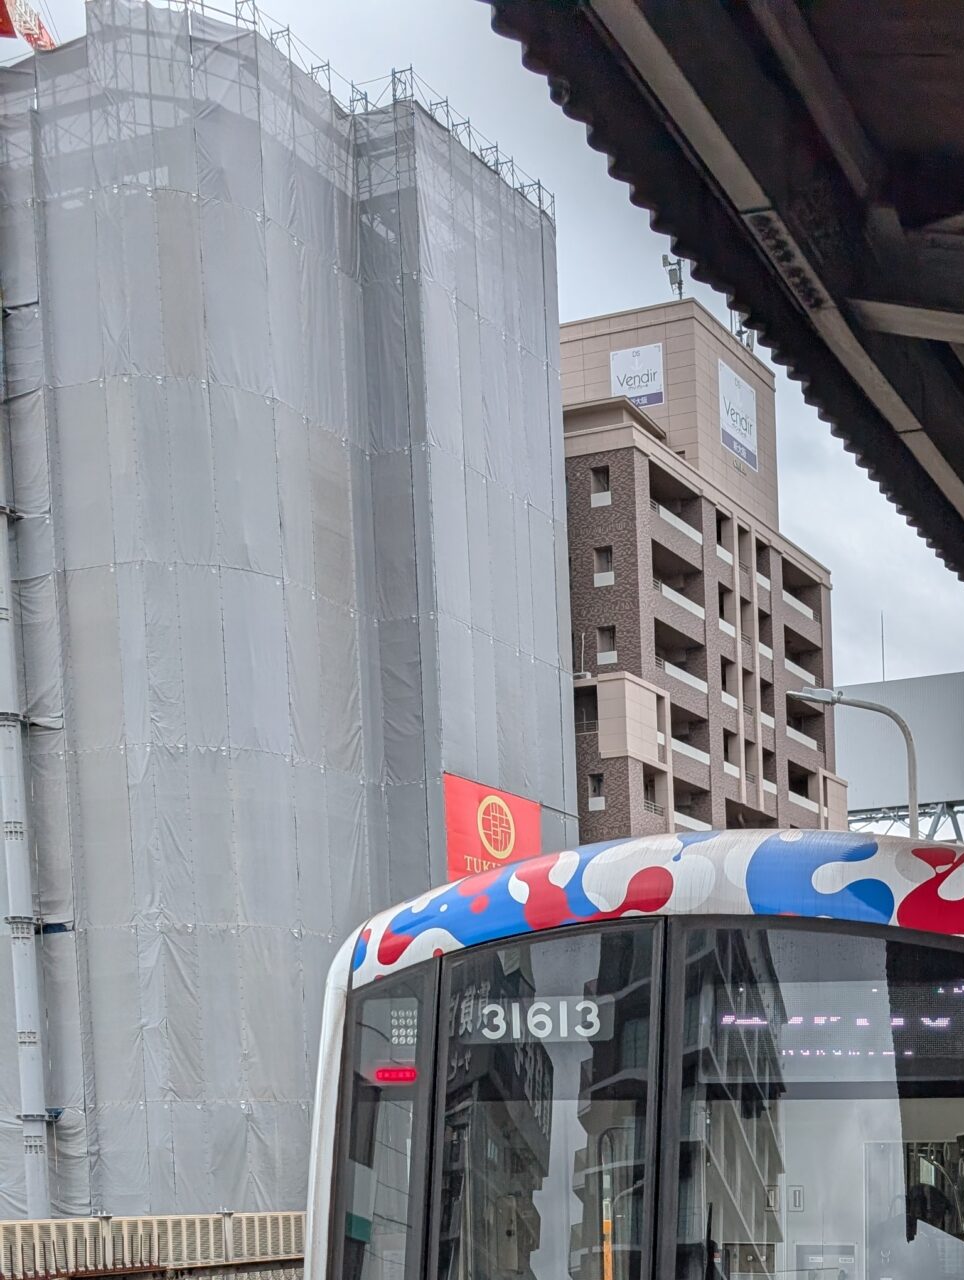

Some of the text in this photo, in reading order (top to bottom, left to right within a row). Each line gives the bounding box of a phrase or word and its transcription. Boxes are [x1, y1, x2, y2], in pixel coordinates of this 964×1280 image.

[617, 369, 657, 387] Vendir
[723, 395, 752, 436] Vendir
[482, 1000, 600, 1039] 31613
